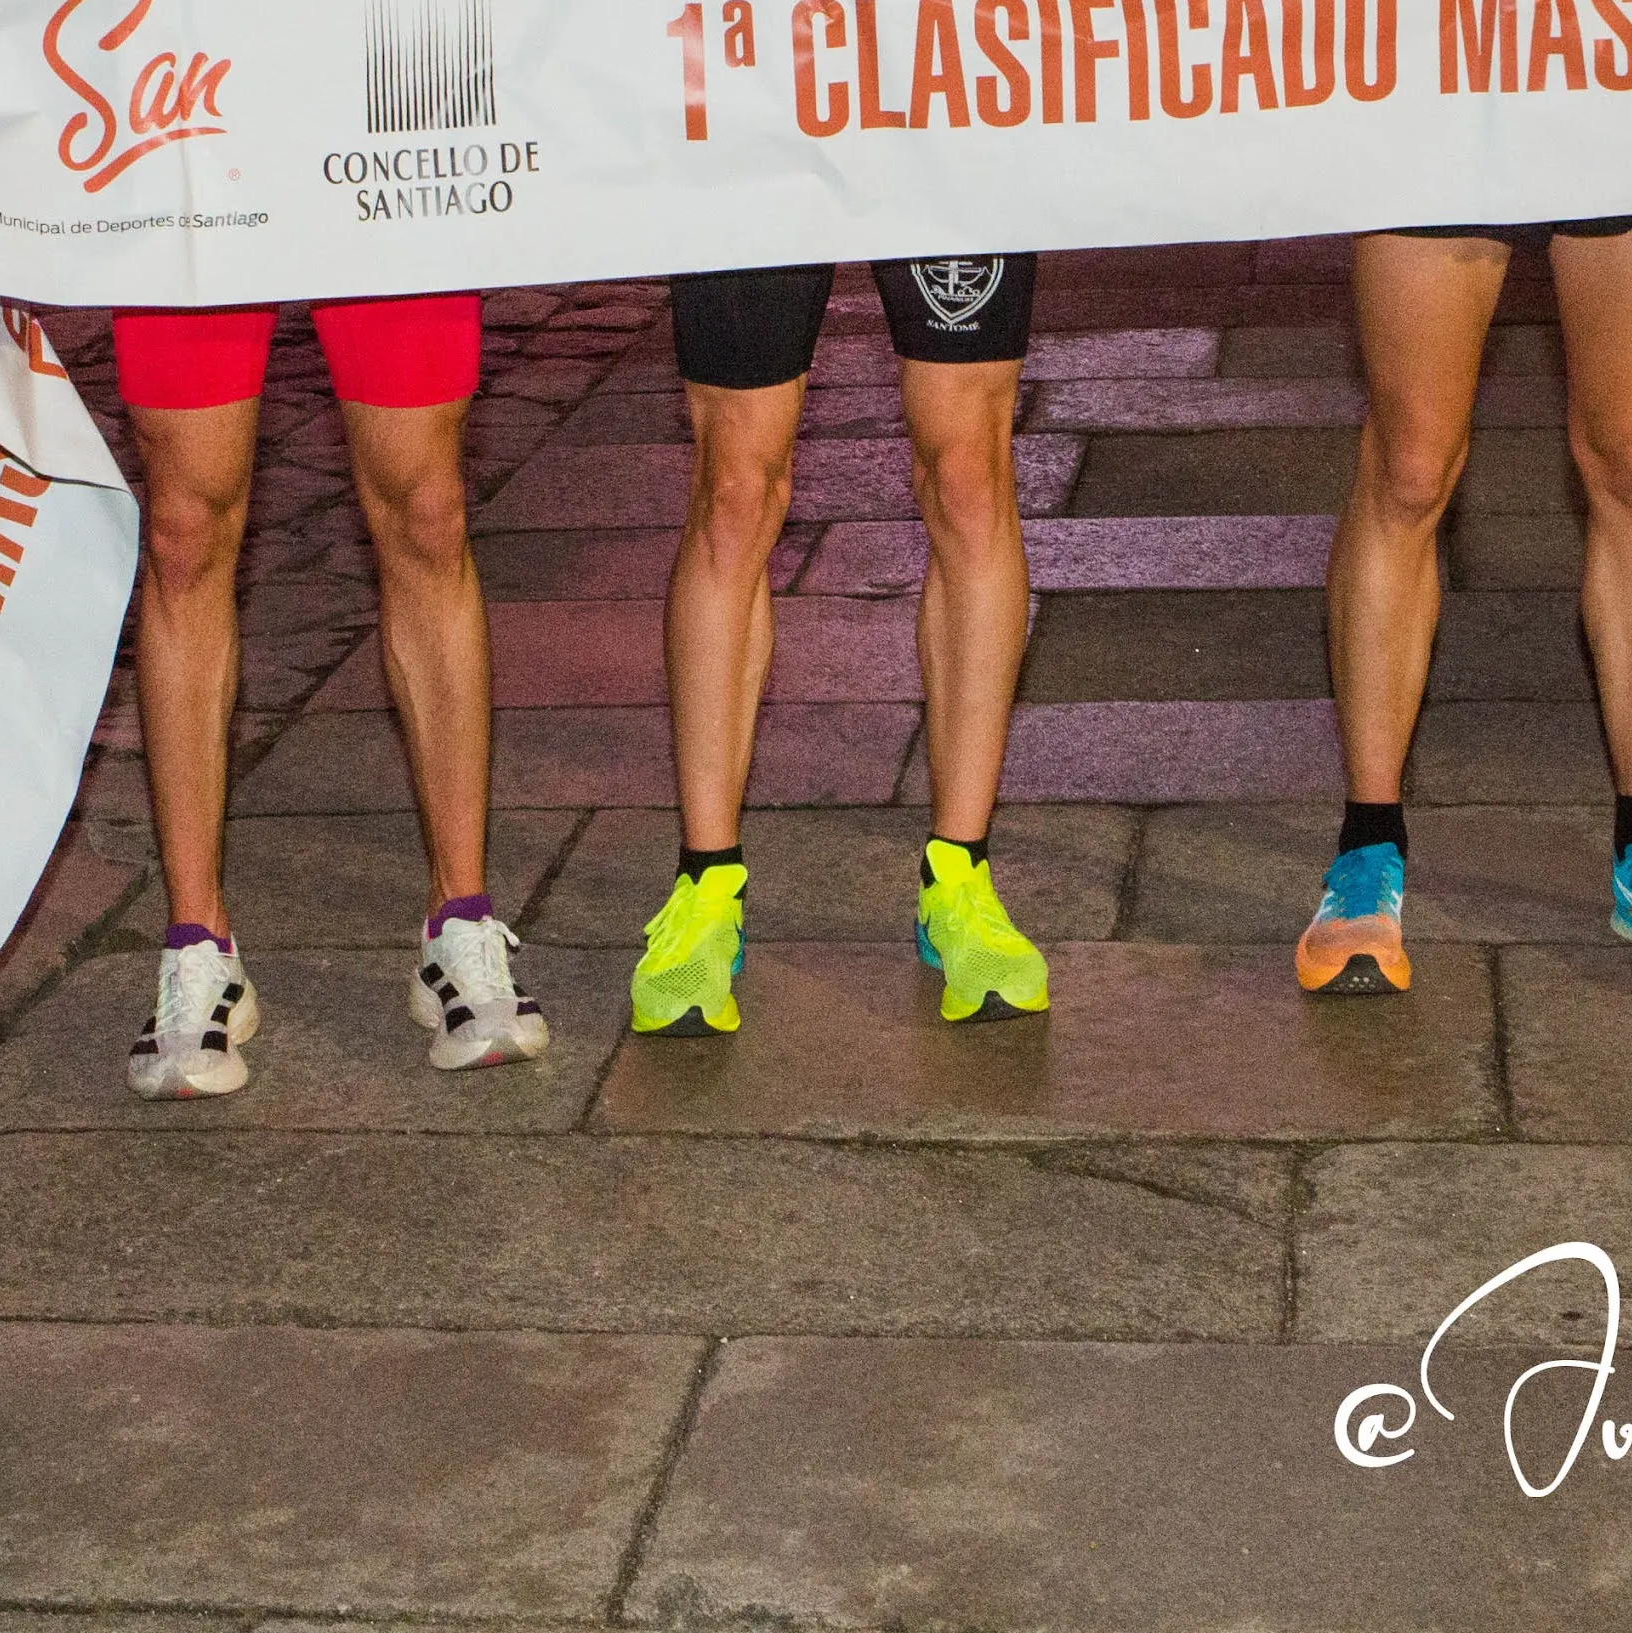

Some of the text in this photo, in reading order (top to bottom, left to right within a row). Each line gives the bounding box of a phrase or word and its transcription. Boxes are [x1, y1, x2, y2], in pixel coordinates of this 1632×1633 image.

[324, 140, 541, 187] CONCELLO DE
[71, 219, 92, 234] de
[97, 213, 176, 234] Deportes
[192, 210, 269, 230] Santiago
[356, 180, 514, 224] SANTIAGO
